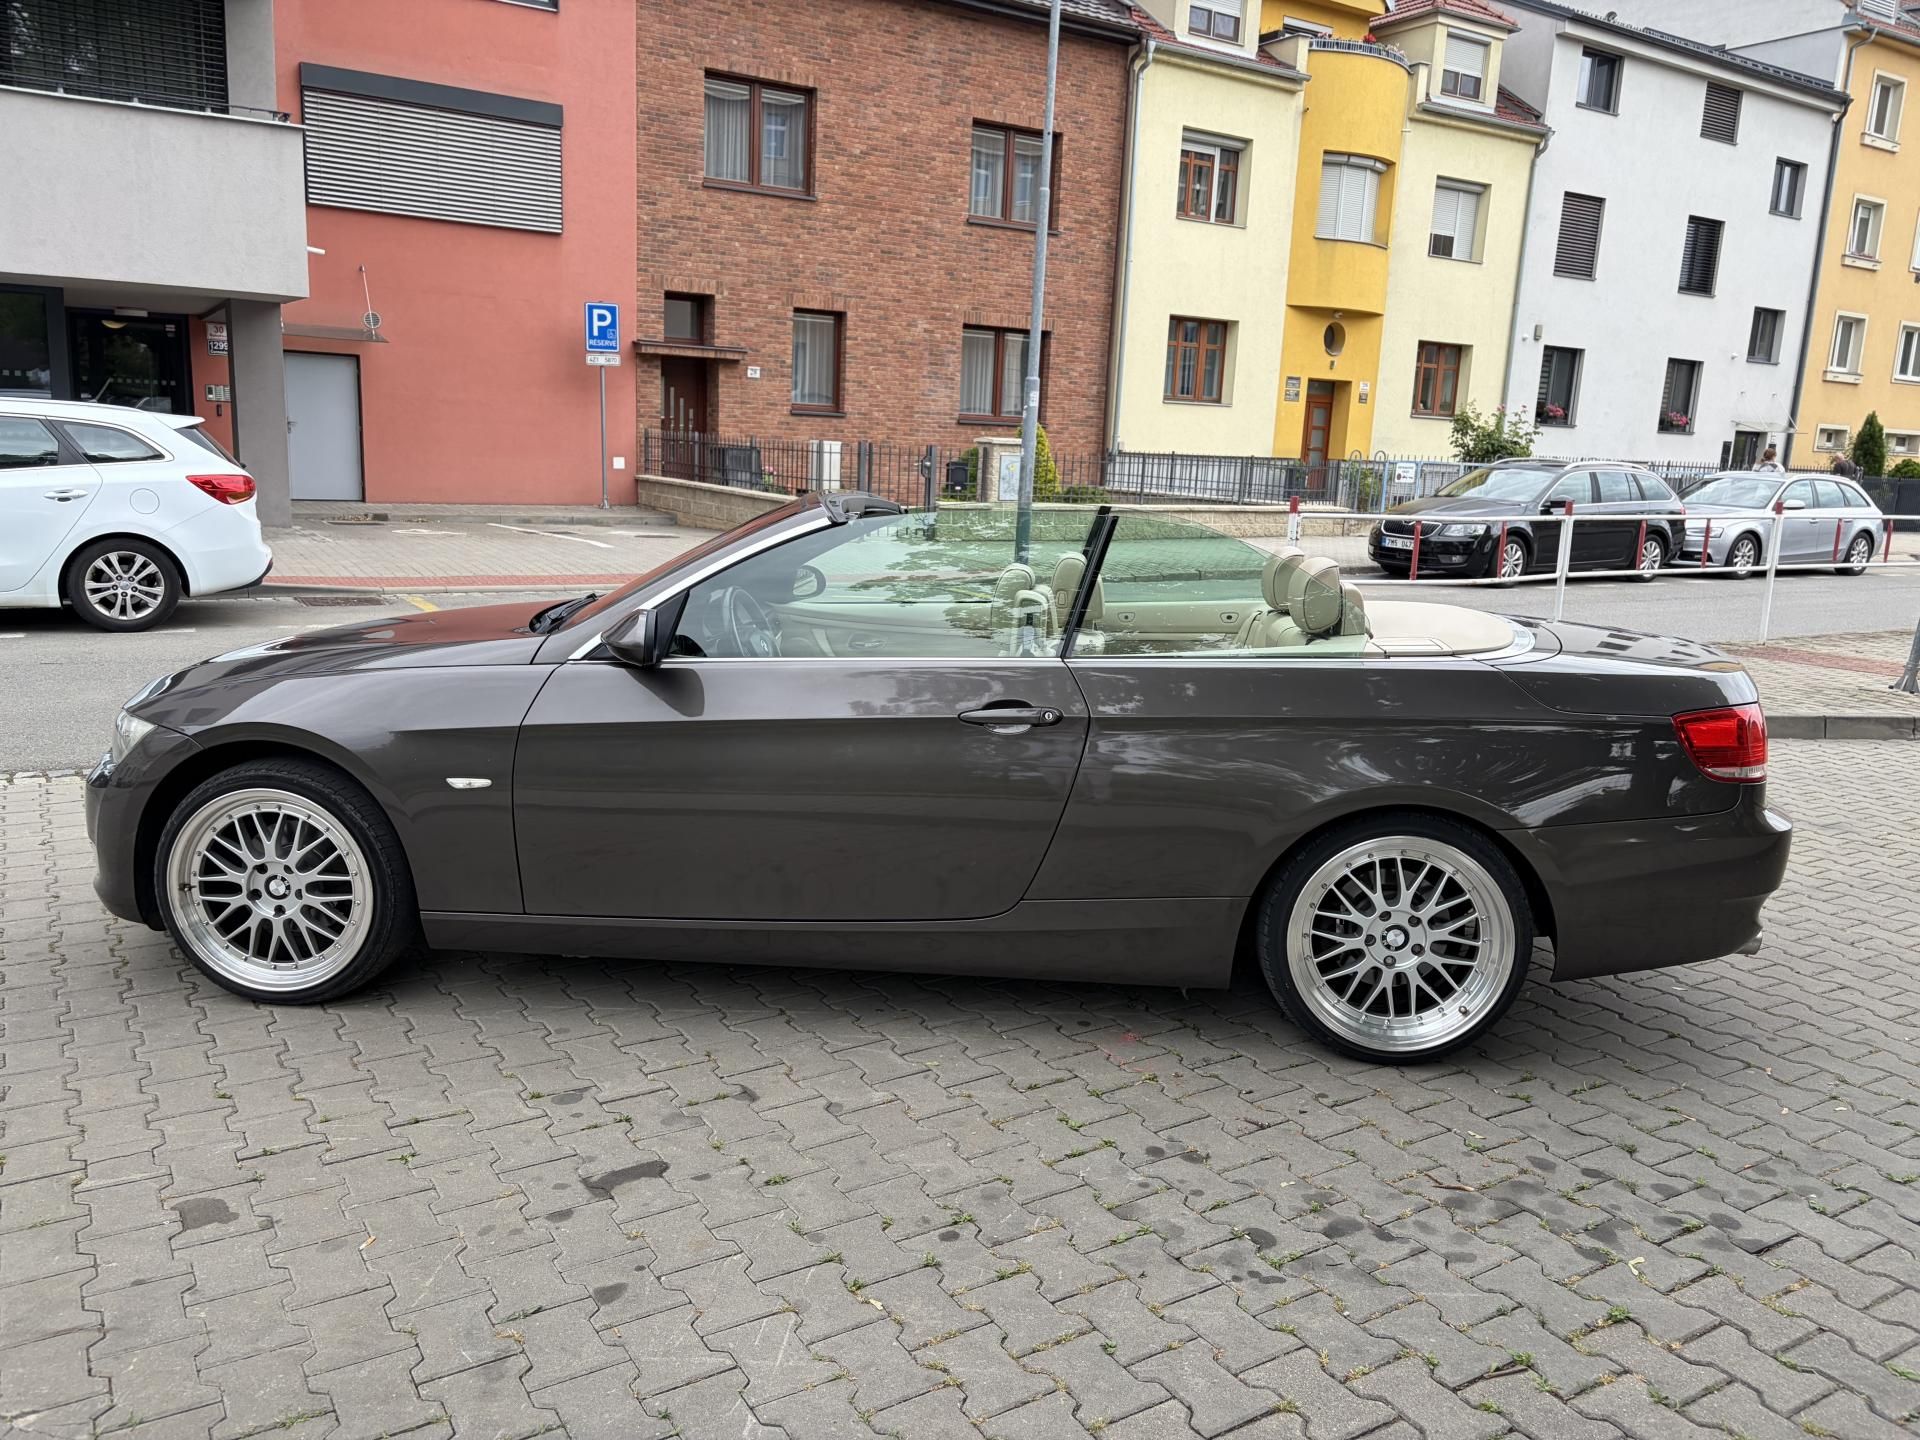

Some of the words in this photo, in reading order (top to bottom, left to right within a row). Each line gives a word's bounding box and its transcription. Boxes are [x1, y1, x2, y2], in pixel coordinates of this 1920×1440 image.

[593, 308, 612, 336] P
[214, 325, 224, 334] 30
[210, 341, 229, 350] 1299
